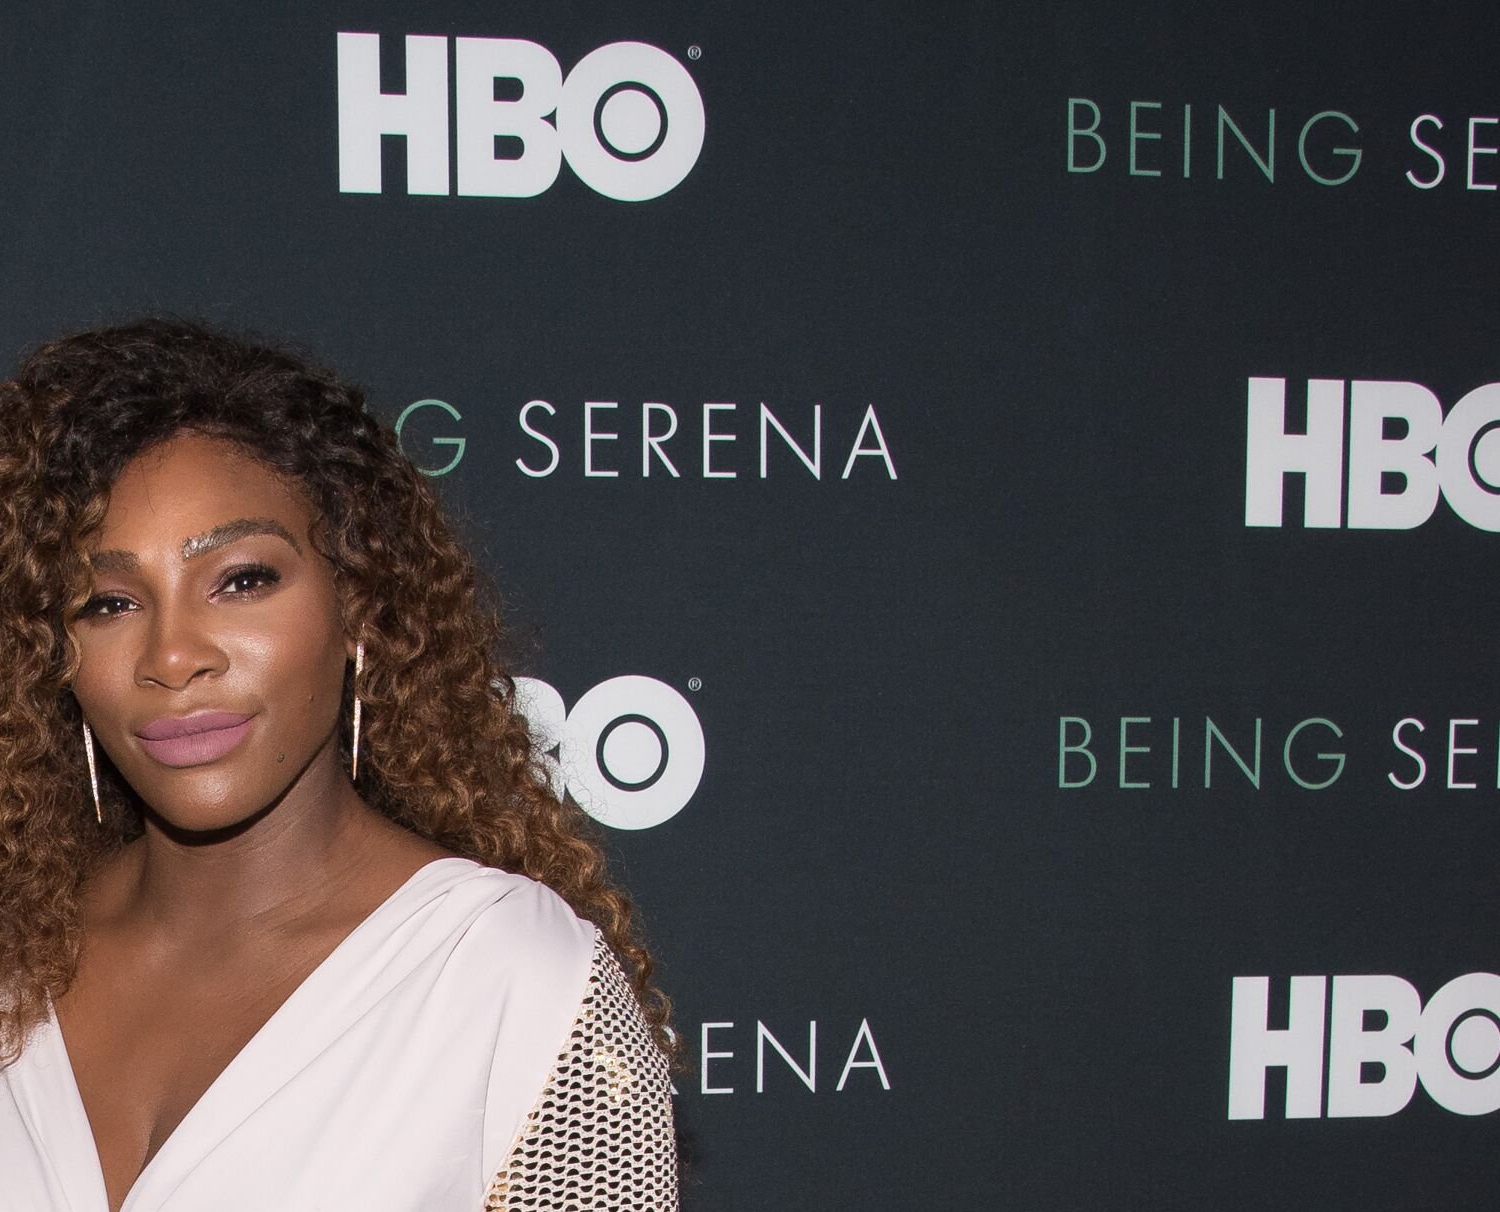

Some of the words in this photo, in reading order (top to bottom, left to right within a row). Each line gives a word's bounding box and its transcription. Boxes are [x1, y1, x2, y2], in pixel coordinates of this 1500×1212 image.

[336, 31, 706, 202] HBO
[1067, 97, 1363, 186] BEING
[1405, 113, 1500, 191] SE
[515, 399, 898, 481] SERENA
[1058, 715, 1346, 790] BEING
[1387, 717, 1500, 790] SE
[663, 1016, 891, 1096] ENA
